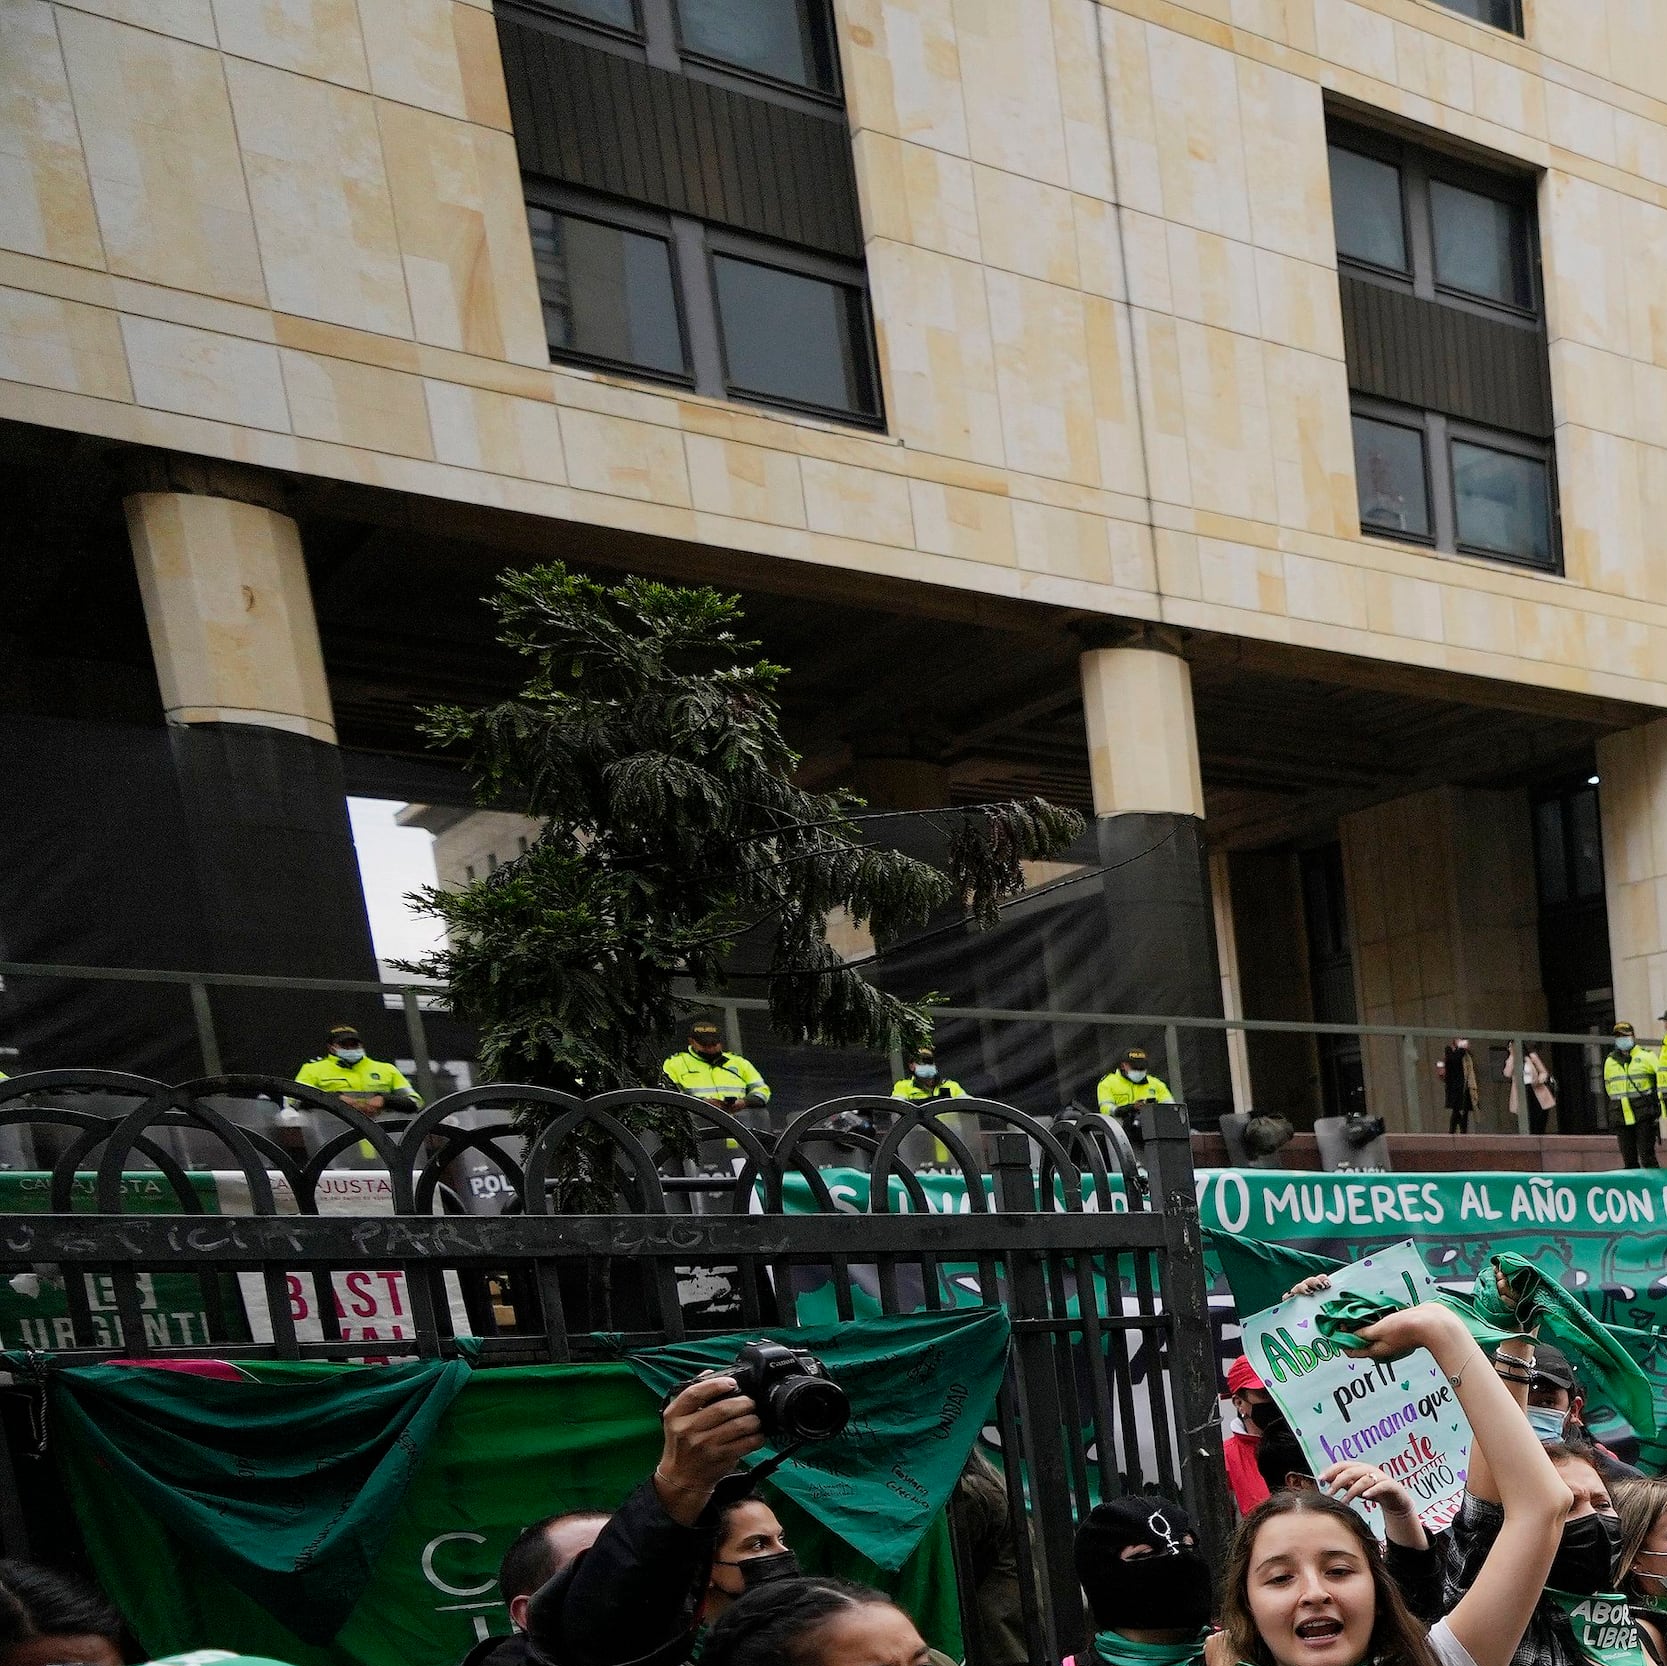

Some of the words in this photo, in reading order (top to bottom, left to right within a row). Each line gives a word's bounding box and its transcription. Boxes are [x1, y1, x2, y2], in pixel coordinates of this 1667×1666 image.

[1264, 1183, 1443, 1226] MUJERES
[1460, 1185, 1502, 1222] AL
[1511, 1177, 1576, 1224] AÑO
[1586, 1187, 1658, 1225] CON
[769, 1356, 796, 1368] Canon
[1320, 1402, 1417, 1465] hermana
[1418, 1385, 1453, 1426] que
[1583, 1625, 1639, 1650] LIBRE
